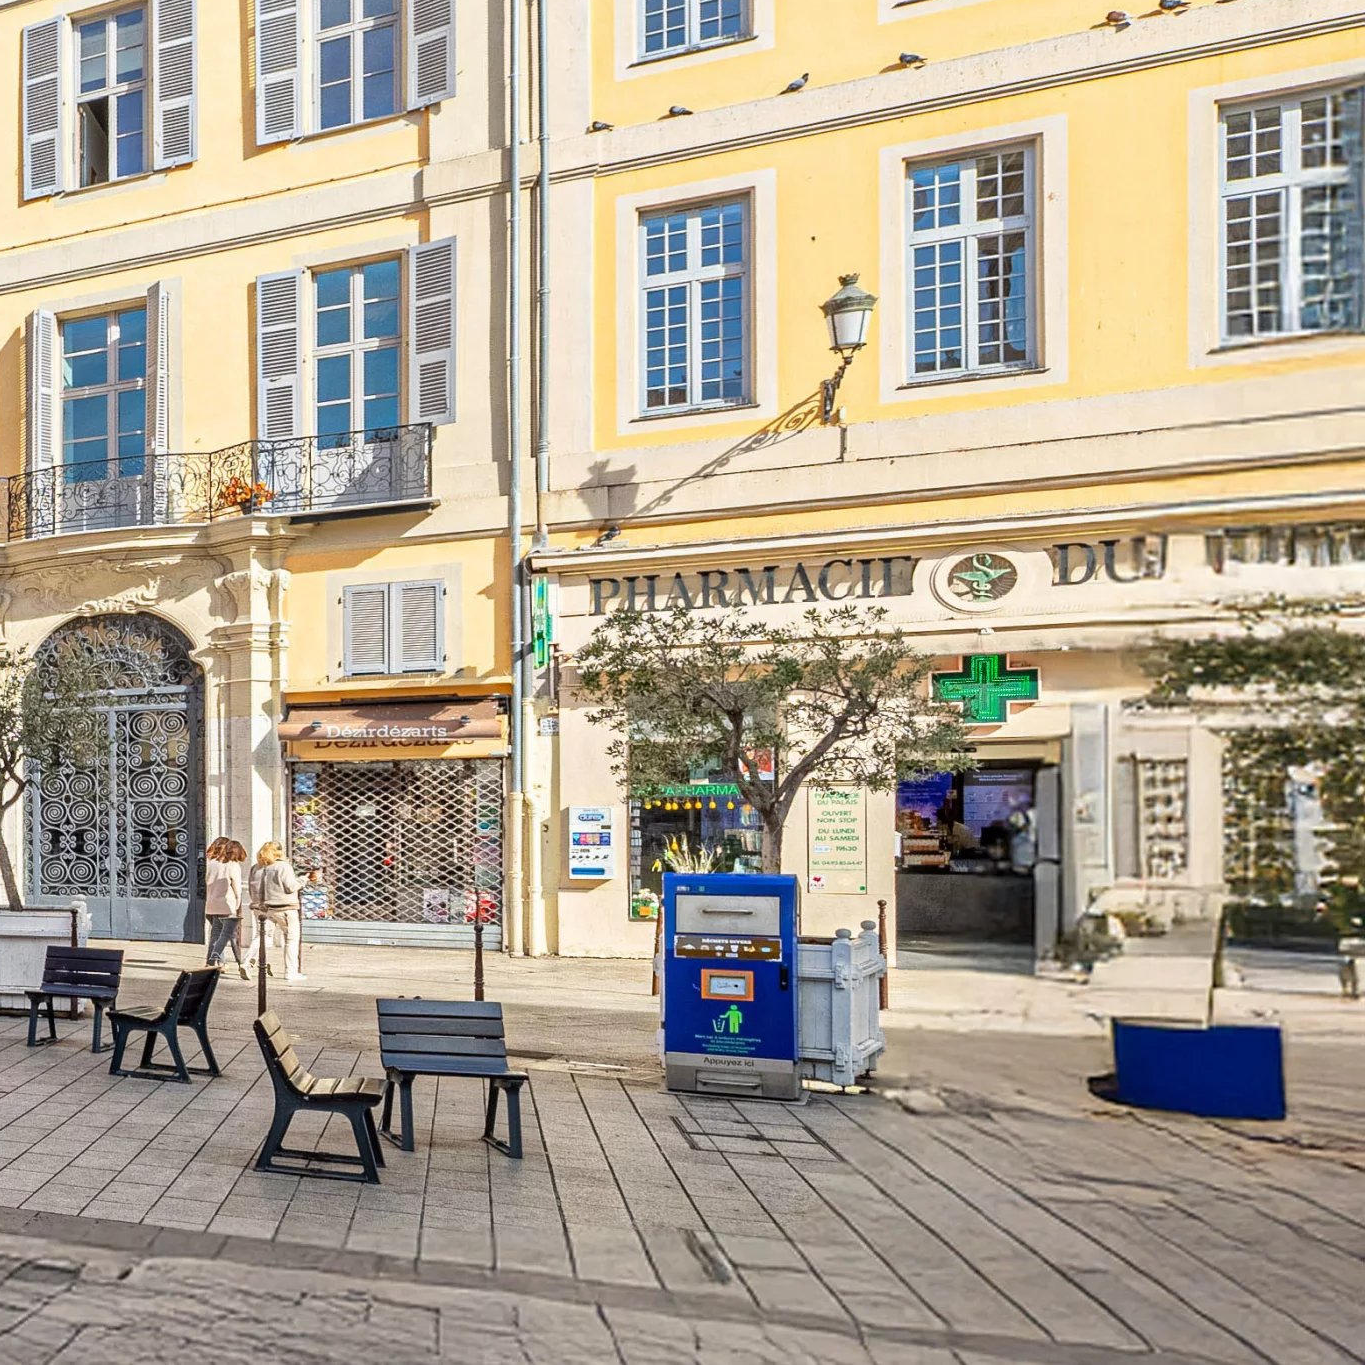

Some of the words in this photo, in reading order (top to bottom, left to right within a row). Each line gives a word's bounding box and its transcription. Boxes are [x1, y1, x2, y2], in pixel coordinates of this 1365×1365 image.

[588, 555, 913, 617] PHARMACIE
[326, 725, 447, 739] Dézirdézarts
[703, 1056, 742, 1067] Appuyez
[744, 1058, 755, 1067] ici
